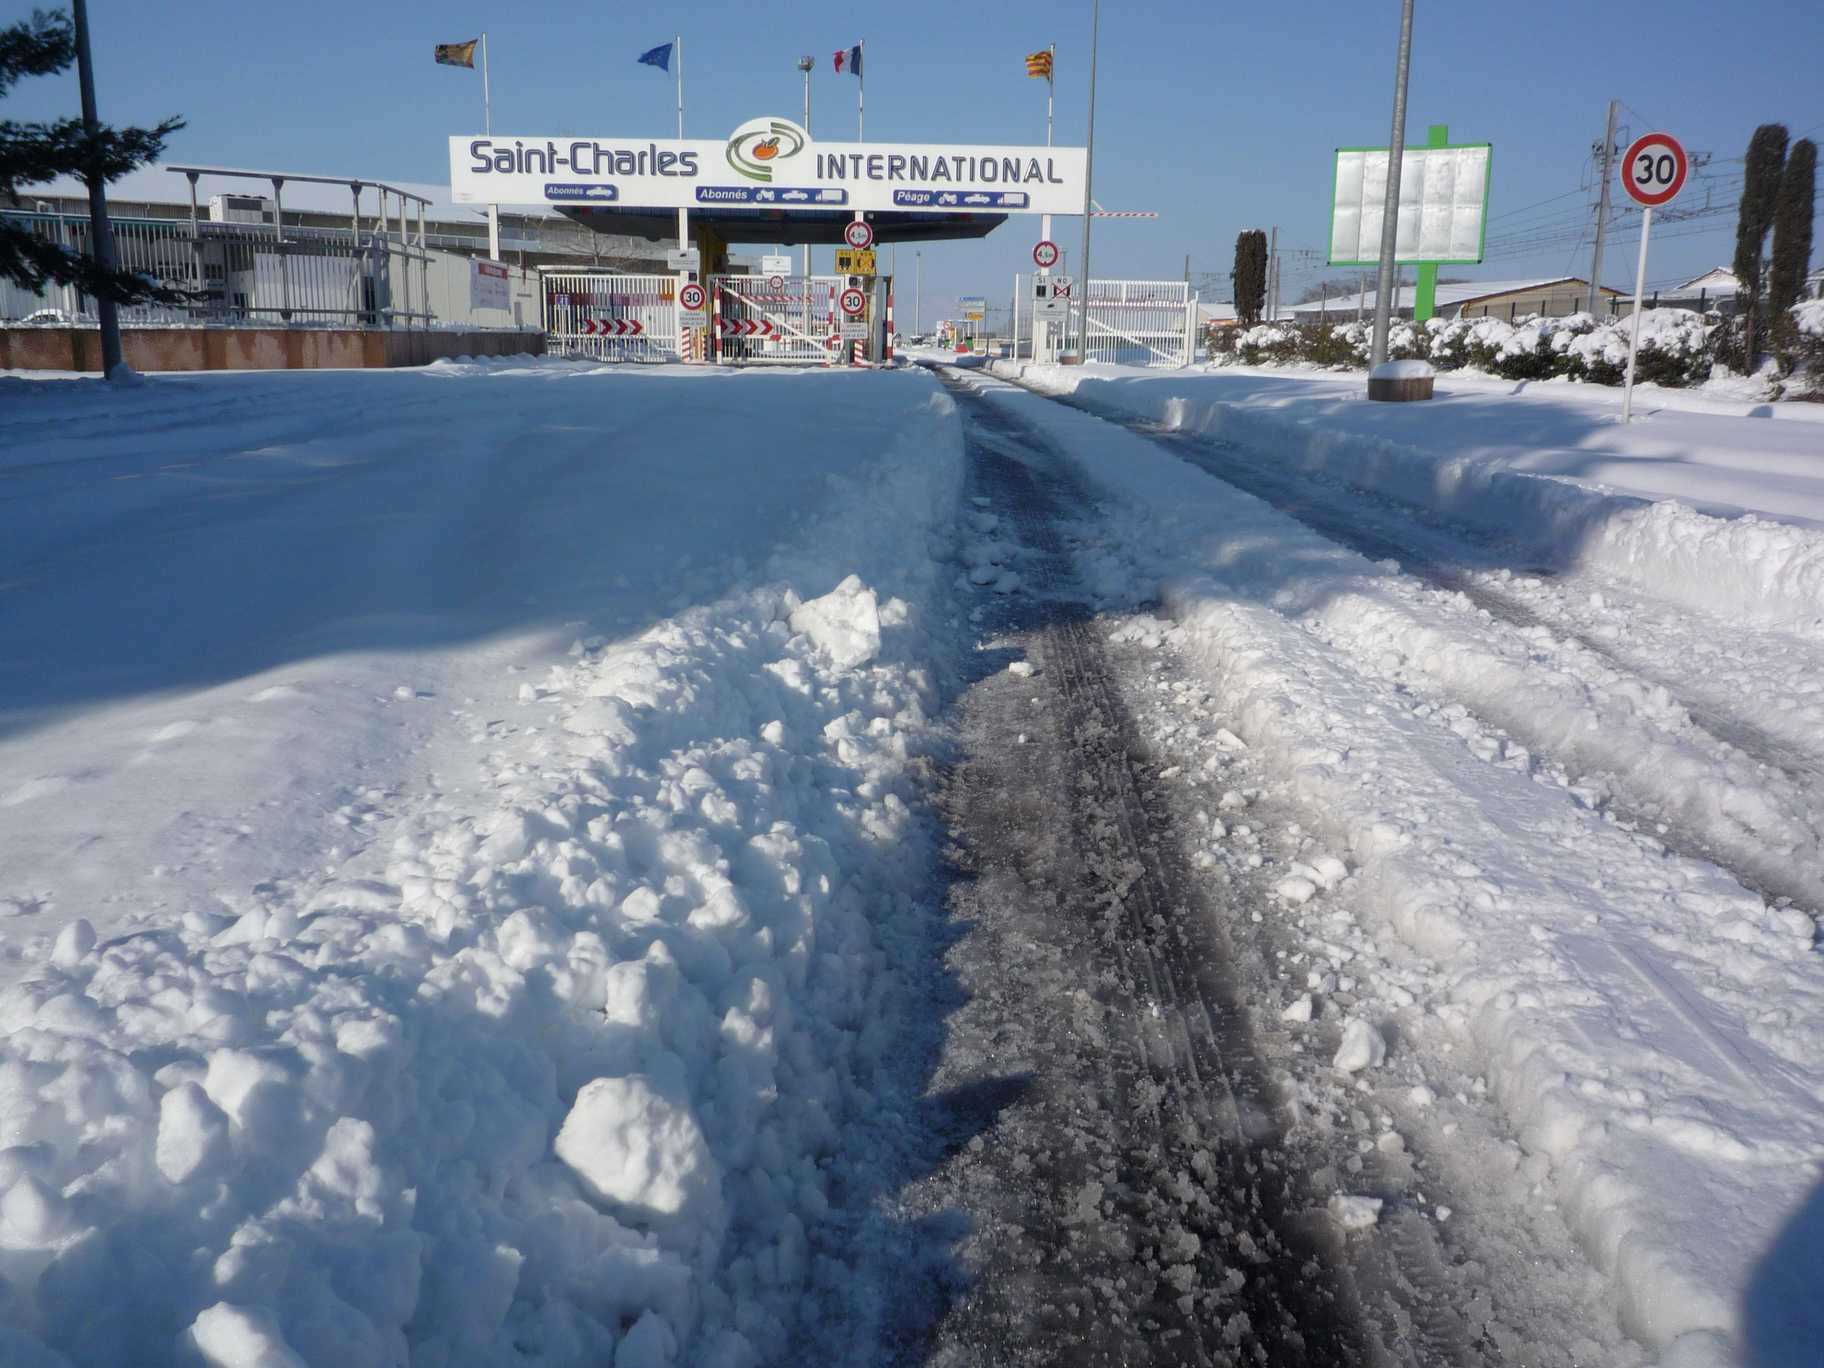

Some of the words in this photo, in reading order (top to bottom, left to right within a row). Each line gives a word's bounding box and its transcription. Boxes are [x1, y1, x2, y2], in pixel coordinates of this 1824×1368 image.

[470, 140, 698, 177] Saint-Charles
[816, 153, 1064, 184] INTERNATIONAL
[1635, 154, 1675, 185] 30
[700, 188, 748, 199] Abonnés
[897, 190, 930, 204] Péage
[685, 291, 700, 303] 30
[846, 295, 860, 307] 30
